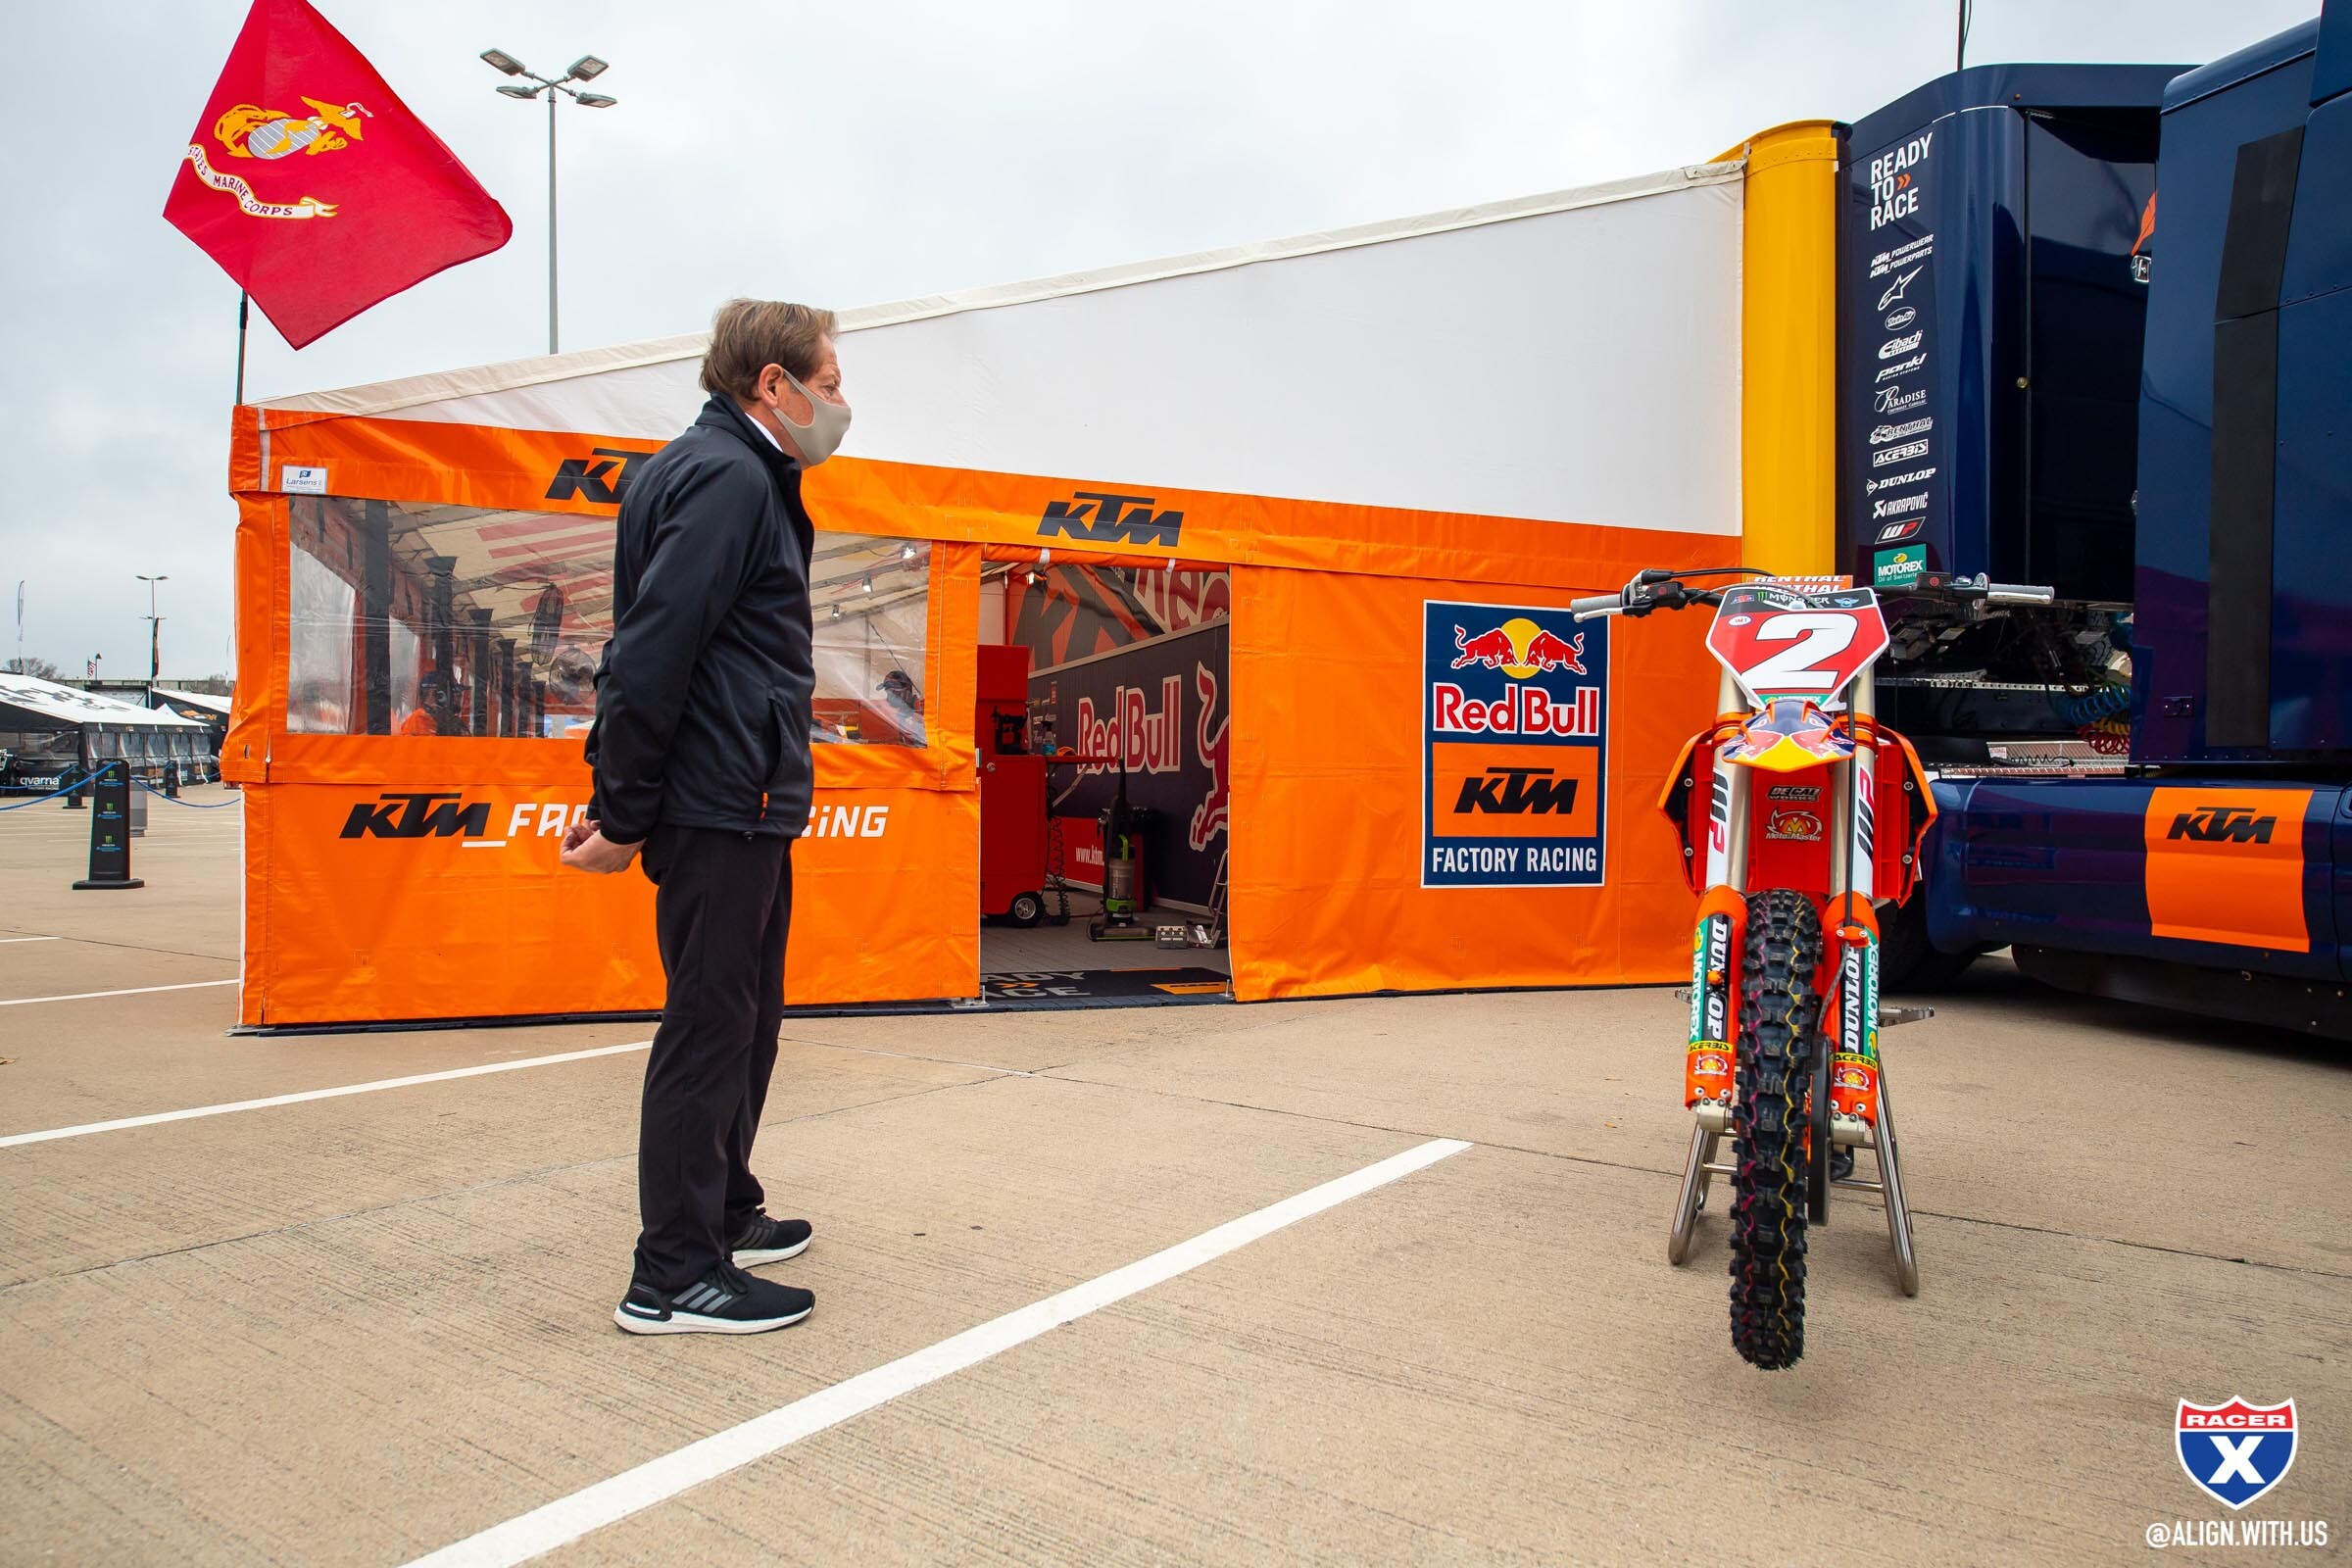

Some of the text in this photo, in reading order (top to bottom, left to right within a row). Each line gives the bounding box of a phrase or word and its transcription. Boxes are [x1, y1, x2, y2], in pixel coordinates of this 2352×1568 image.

[1870, 132, 1934, 184] READY
[213, 173, 249, 202] MARINE
[243, 200, 293, 217] CORPS
[1870, 175, 1895, 207] TO
[1870, 186, 1919, 231] RACE
[1887, 416, 1933, 435] RENTHAL
[545, 447, 656, 503] KT
[1879, 467, 1936, 490] DUNLOP
[1036, 491, 1184, 547] KTM
[1881, 520, 1919, 540] WP
[1878, 560, 1924, 577] MOTOREX
[1740, 612, 1859, 689] 2
[1453, 767, 1579, 814] KTM
[339, 793, 492, 839] KTM
[2166, 807, 2278, 845] KTM
[1432, 847, 1597, 872] FACTORY RACING
[1690, 953, 1704, 1040] MOTOREX
[1707, 918, 1728, 1041] DUNOP
[1866, 938, 1880, 1030] MOTOREX
